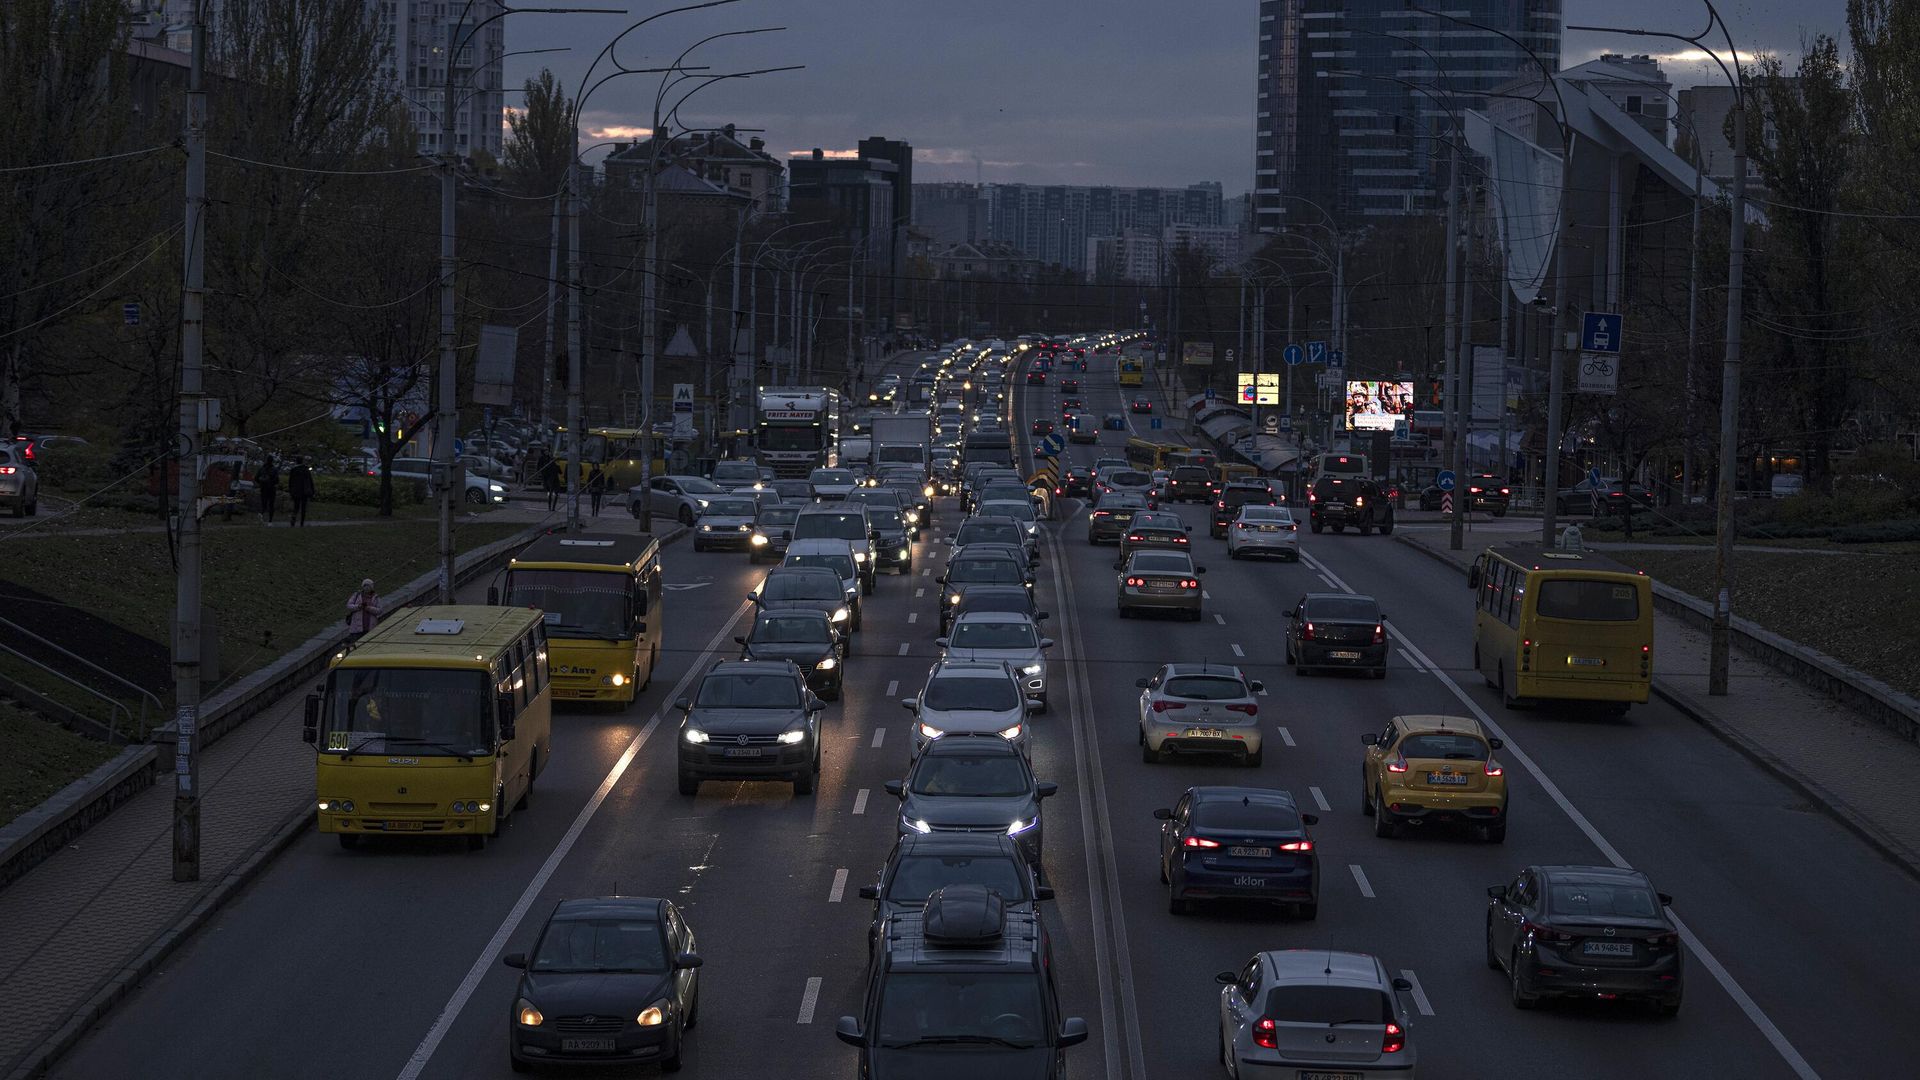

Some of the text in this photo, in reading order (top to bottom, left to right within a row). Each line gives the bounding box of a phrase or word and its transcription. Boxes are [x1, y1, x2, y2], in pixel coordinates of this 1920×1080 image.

[330, 733, 348, 750] 590
[1233, 875, 1265, 887] uklon
[1601, 944, 1618, 952] 9484
